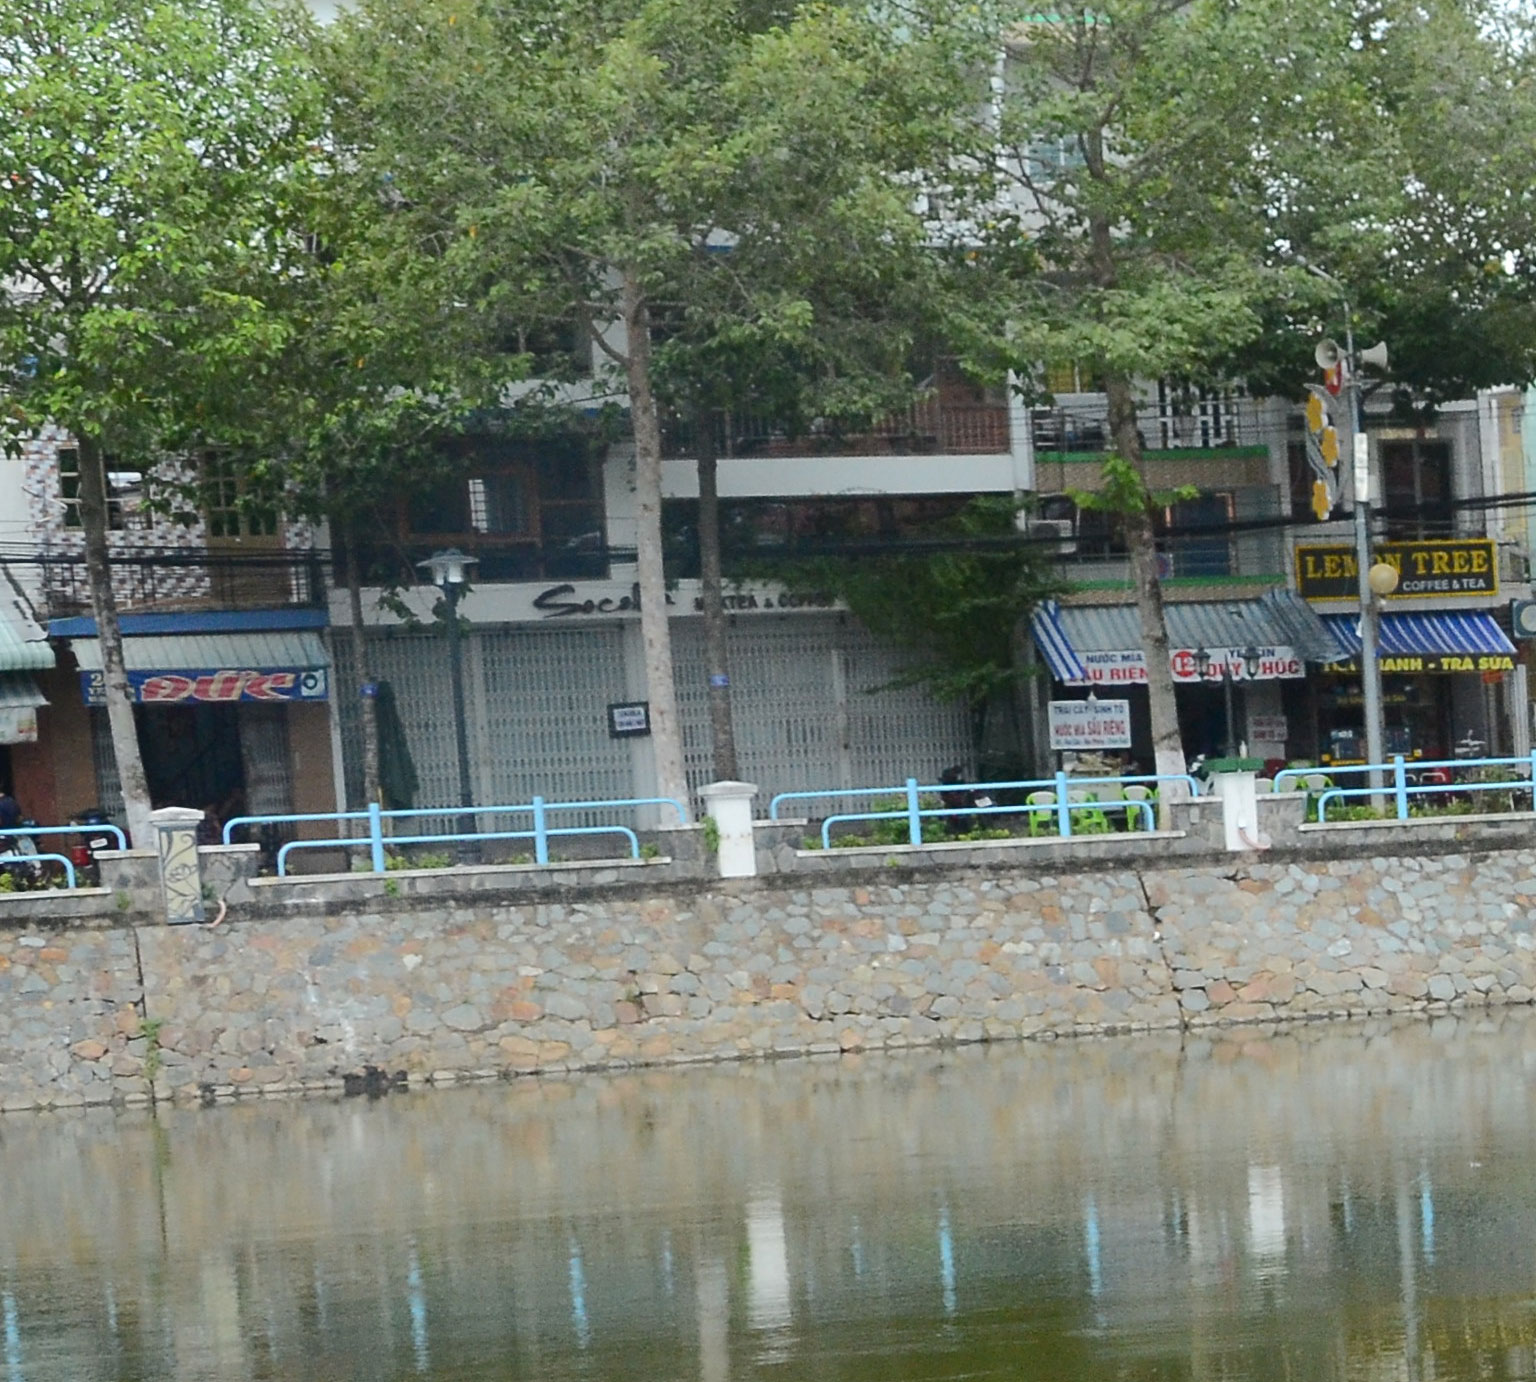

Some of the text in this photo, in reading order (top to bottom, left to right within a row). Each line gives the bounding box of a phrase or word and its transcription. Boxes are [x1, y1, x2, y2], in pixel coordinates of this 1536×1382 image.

[1411, 550, 1488, 576] TREE
[1402, 577, 1486, 592] COFFEE & TEA
